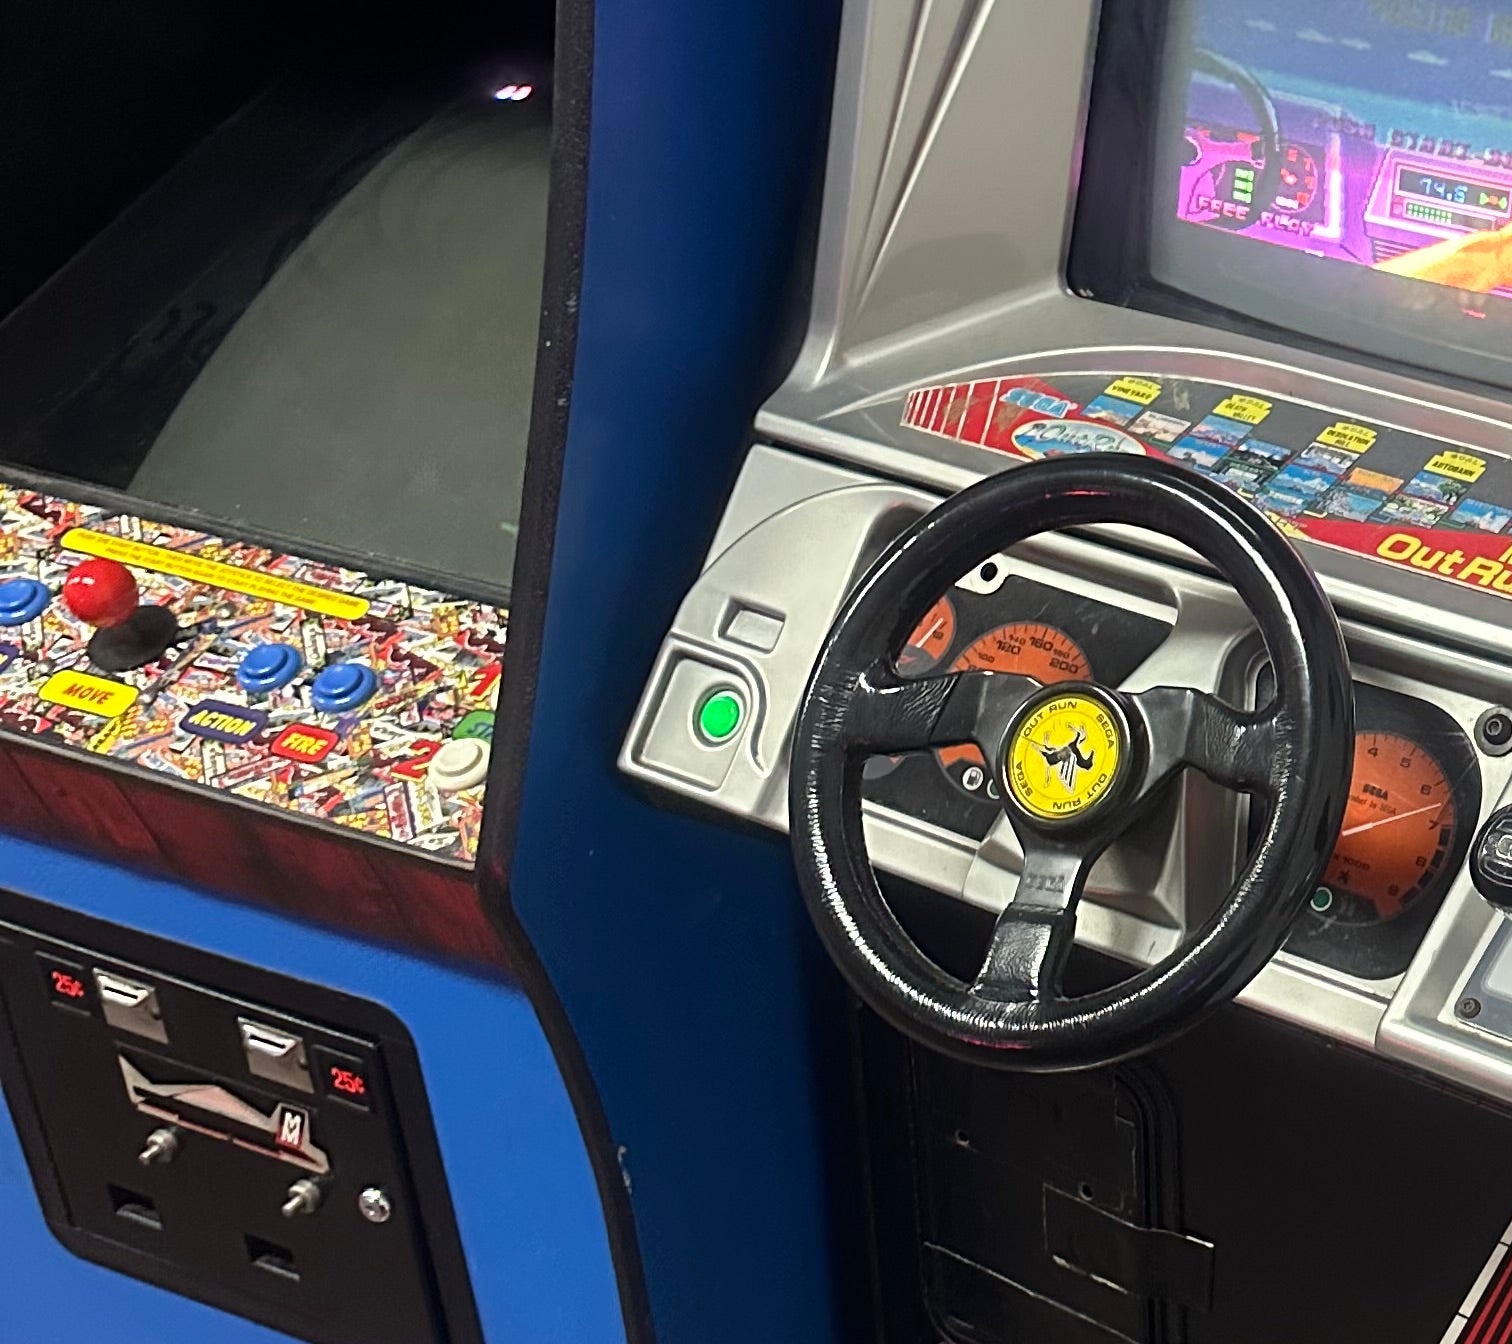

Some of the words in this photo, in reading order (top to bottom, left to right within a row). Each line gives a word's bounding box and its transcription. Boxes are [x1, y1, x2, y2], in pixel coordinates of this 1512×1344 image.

[1198, 196, 1251, 221] FREE
[62, 682, 115, 706] MOVE
[188, 708, 257, 737] ACTION
[1023, 713, 1045, 739] OUT
[1048, 701, 1079, 715] RUN
[1096, 712, 1115, 751] SEGA
[281, 731, 329, 757] FIRE
[329, 1066, 367, 1096] 25¢
